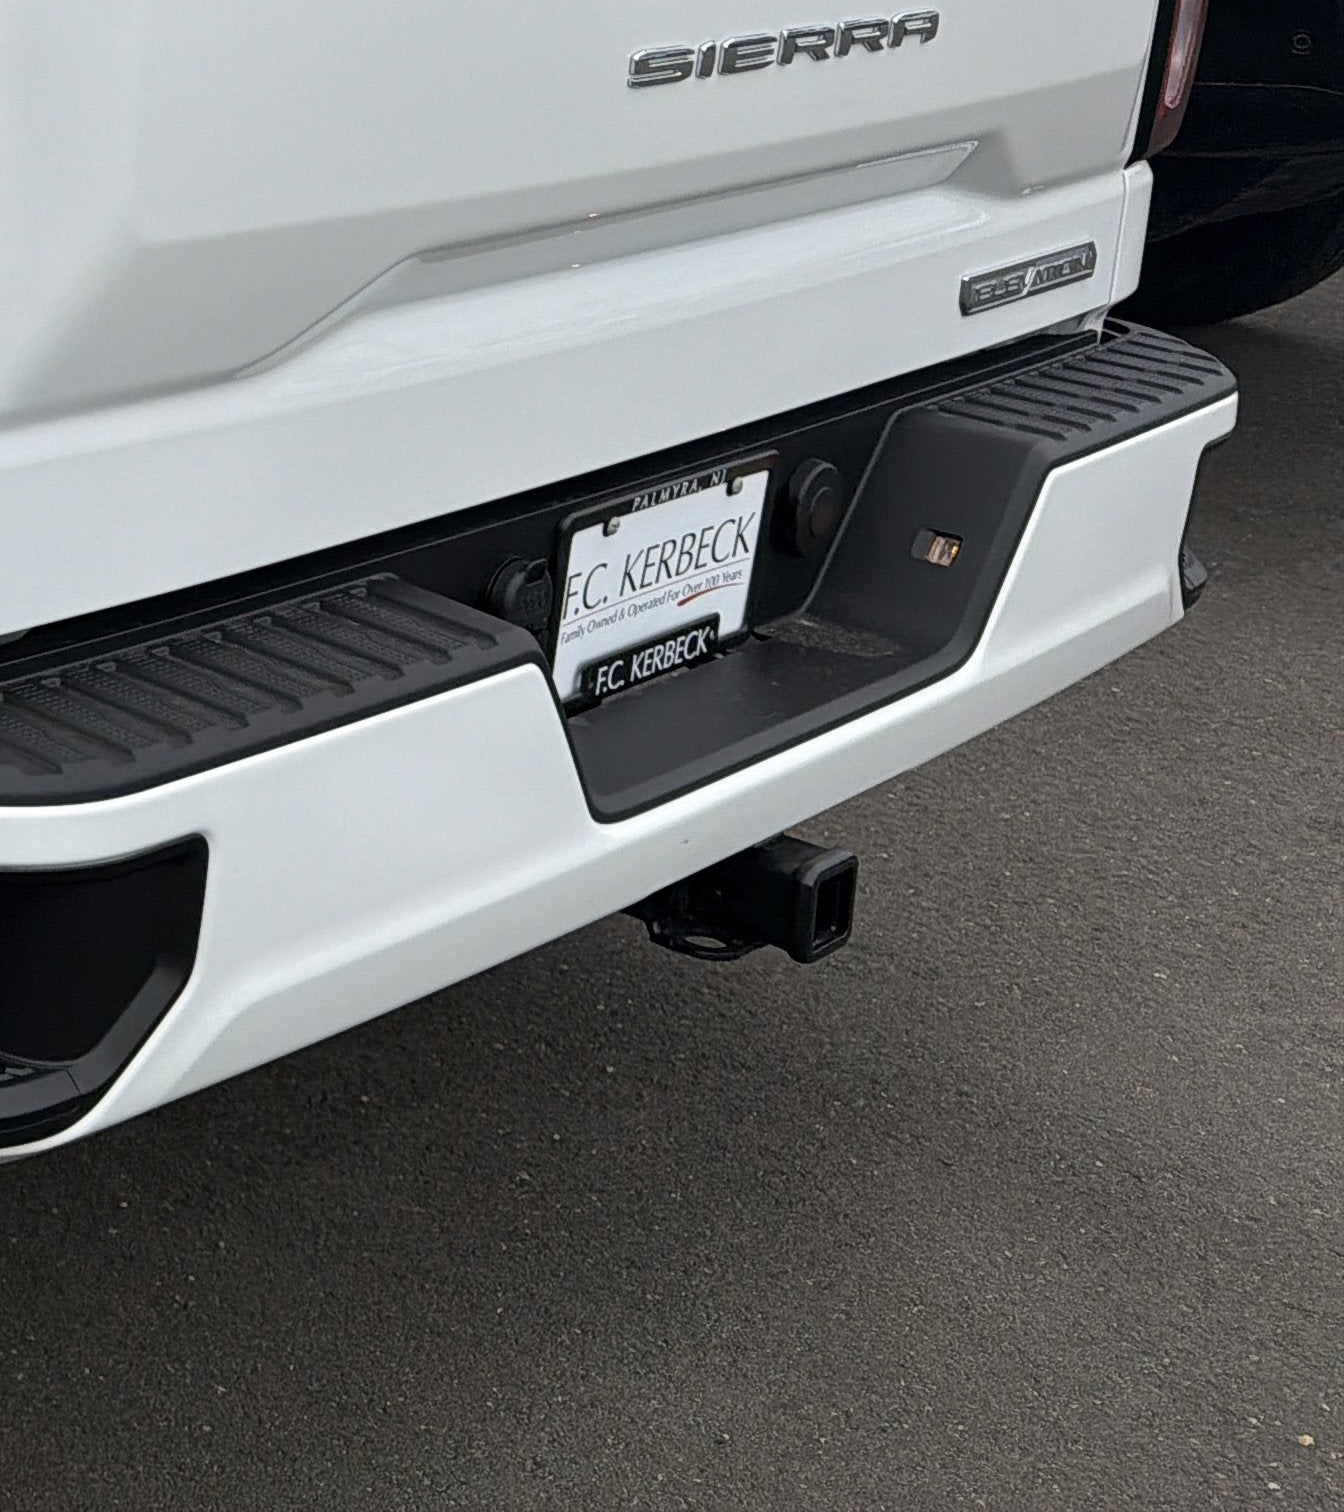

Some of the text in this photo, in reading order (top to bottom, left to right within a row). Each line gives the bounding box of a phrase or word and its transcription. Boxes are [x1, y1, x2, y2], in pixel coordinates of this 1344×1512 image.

[627, 8, 940, 88] SIERRA
[562, 512, 756, 620] F.C. KERBECK
[561, 623, 586, 646] Family
[587, 609, 617, 634] Owned
[618, 607, 626, 621] &
[627, 591, 666, 618] Operated
[667, 587, 681, 604] For
[682, 582, 703, 597] Over
[722, 569, 743, 584] Years
[595, 626, 710, 696] F.C. KERBECK
